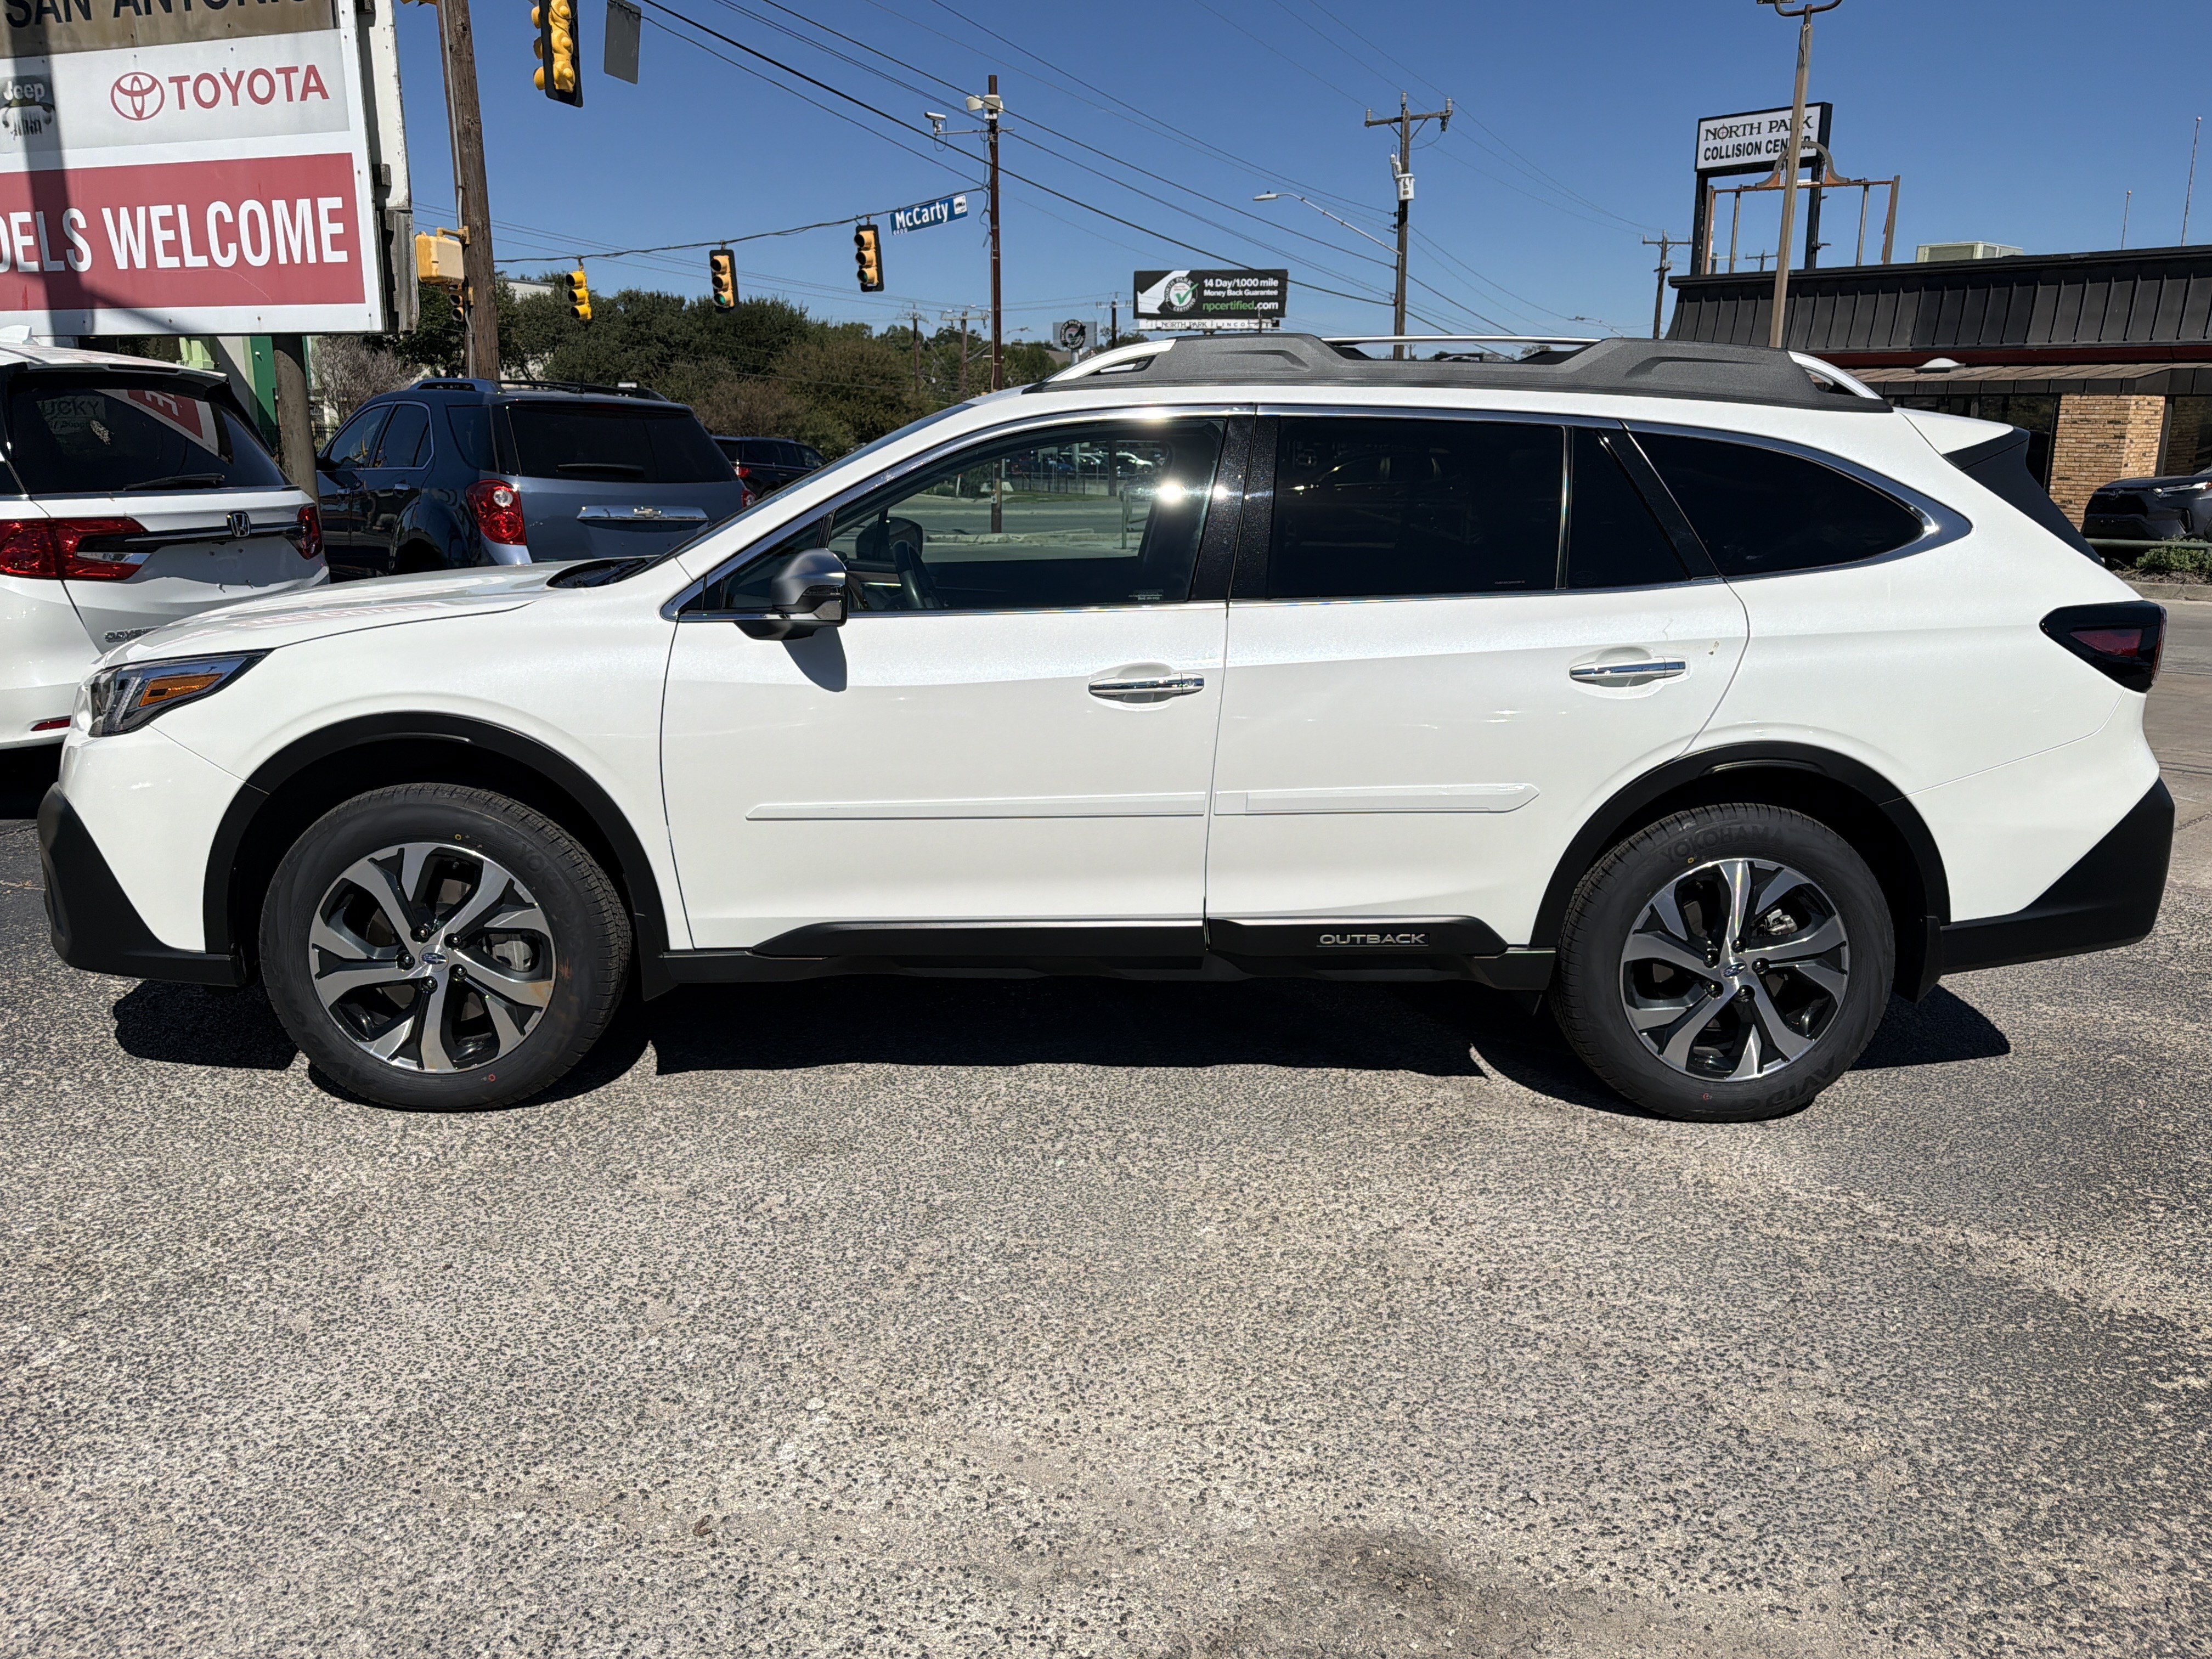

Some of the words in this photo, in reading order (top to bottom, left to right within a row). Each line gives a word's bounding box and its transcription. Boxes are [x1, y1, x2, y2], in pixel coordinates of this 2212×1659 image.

[5, 0, 92, 27] SAN
[3, 80, 45, 102] Jeep
[168, 64, 330, 110] TOYOTA
[1703, 121, 1762, 142] NORTH
[1768, 115, 1814, 133] PAK
[1703, 140, 1762, 161] COLLISION
[1765, 136, 1811, 154] CENR
[895, 202, 949, 229] McCarty
[101, 197, 348, 269] WELCOME
[1203, 289, 1226, 298] Money
[1204, 278, 1214, 287] 14
[1260, 278, 1279, 287] mile
[1203, 300, 1279, 312] npcertified.com
[1660, 825, 1784, 862] YOKOHAMA
[1319, 934, 1425, 944] OUTBACK
